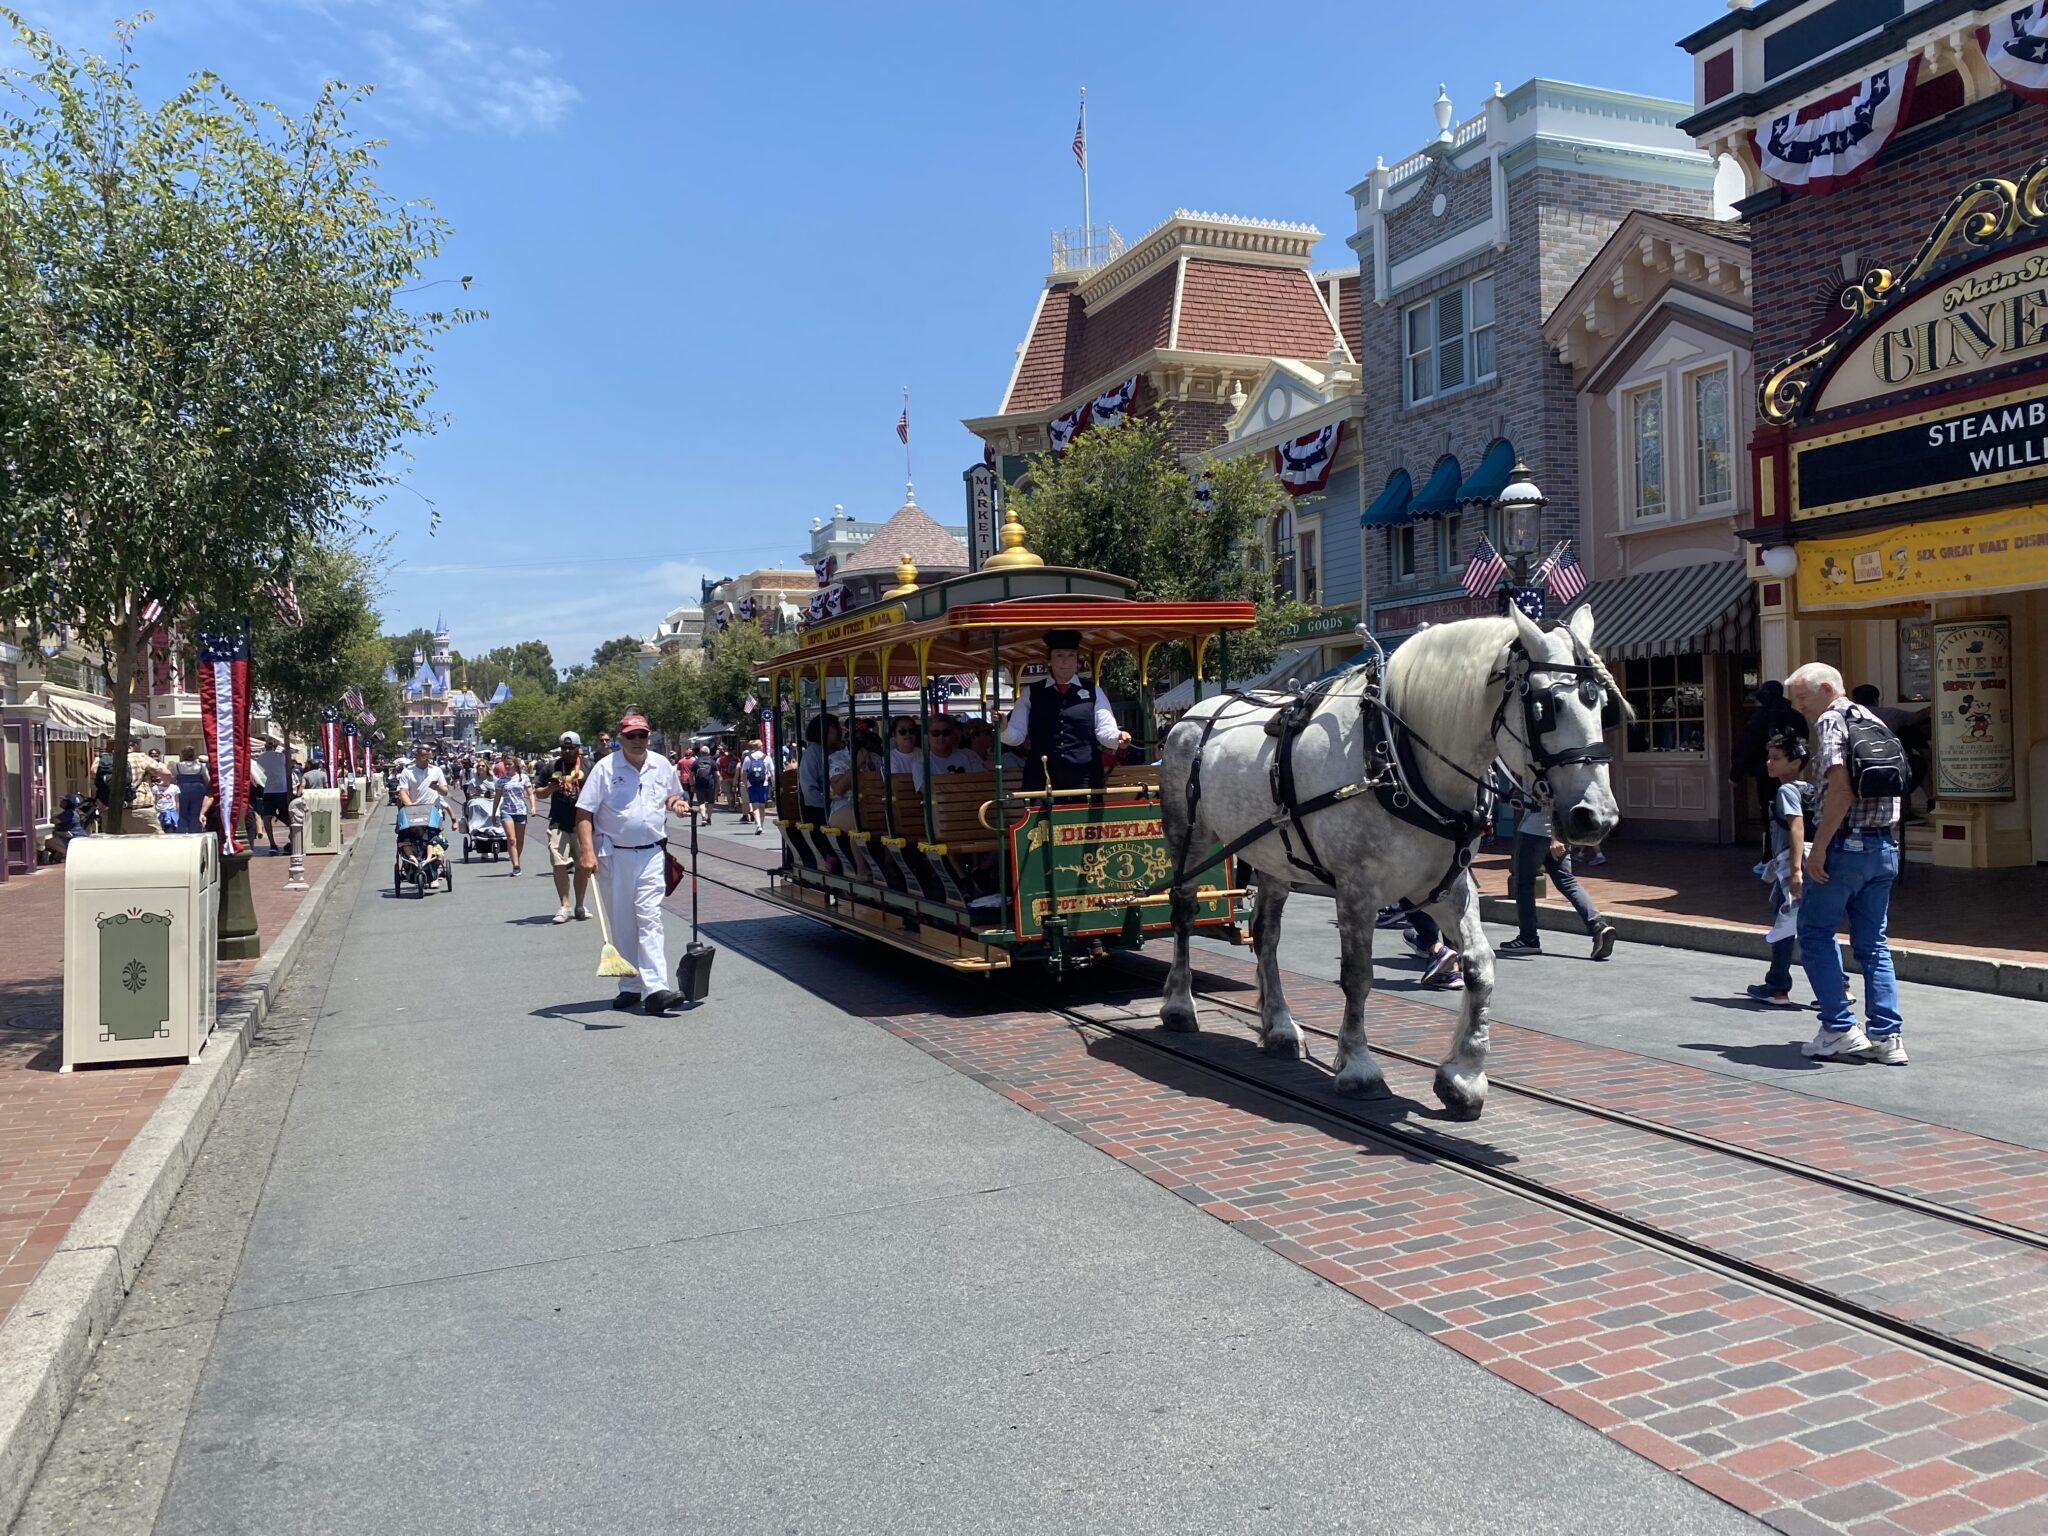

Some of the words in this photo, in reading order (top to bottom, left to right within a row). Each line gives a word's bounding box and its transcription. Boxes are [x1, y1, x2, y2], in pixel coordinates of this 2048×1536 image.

[1943, 272, 2018, 312] Main
[1928, 402, 2047, 448] STEAMB
[975, 475, 990, 543] MARKET
[1916, 548, 1937, 561] SIX
[1939, 543, 1976, 560] GREAT
[1978, 538, 2010, 554] WALT
[842, 620, 865, 636] STREET
[869, 613, 892, 628] PLAZA
[1307, 616, 1343, 632] GOODS
[1406, 607, 1427, 625] THE
[1434, 603, 1466, 618] BOOK
[1104, 843, 1144, 856] STREET
[1116, 853, 1135, 879] 3
